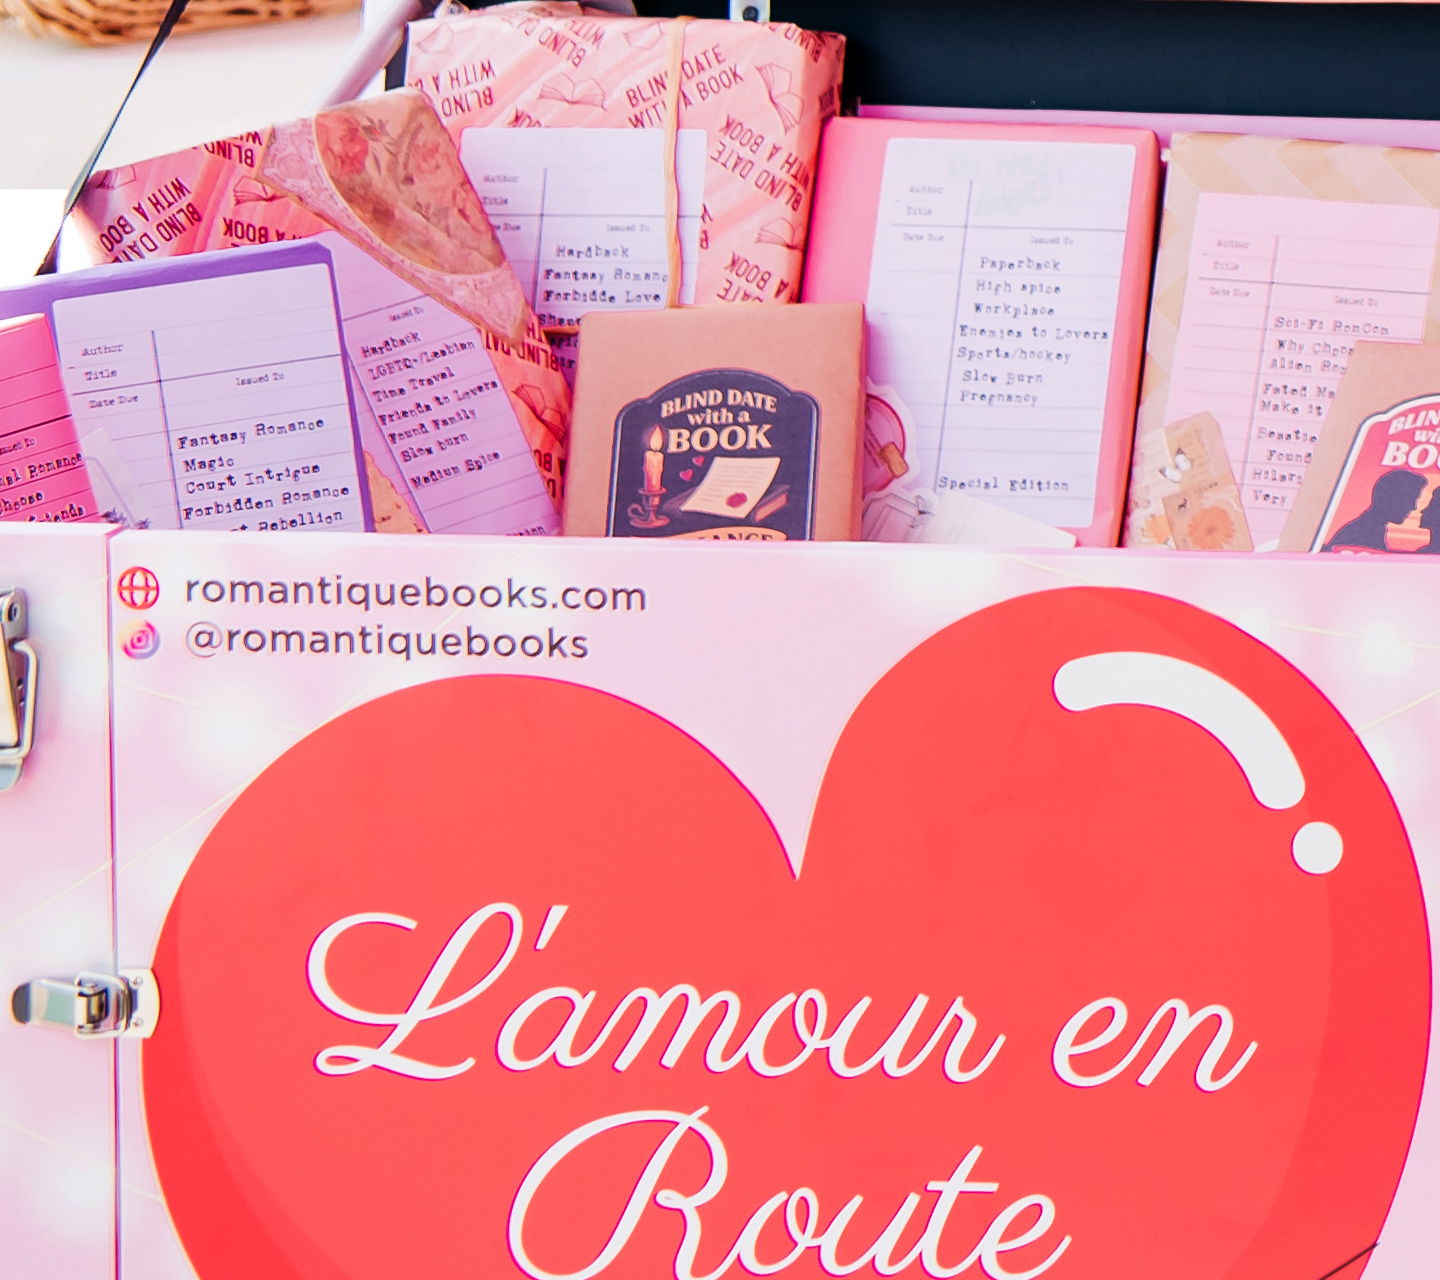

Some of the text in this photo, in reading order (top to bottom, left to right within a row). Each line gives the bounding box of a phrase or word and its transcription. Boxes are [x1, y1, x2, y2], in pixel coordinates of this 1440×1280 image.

[696, 63, 745, 102] BOOK
[441, 86, 494, 118] BLIND
[718, 114, 765, 155] BOOK
[156, 202, 202, 242] BLIND
[543, 268, 606, 286] Fantasy
[979, 256, 1062, 272] Paperback
[974, 302, 1056, 319] Workplace
[1056, 327, 1109, 340] Lovers
[1274, 316, 1390, 336] Sci-Fi RomCom
[956, 346, 1072, 365] Sports/hockey
[408, 366, 455, 391] Travel
[452, 379, 499, 402] Lovers
[660, 388, 778, 419] BLIND DATE
[960, 389, 1039, 407] Pregnancy
[687, 407, 751, 426] with a
[177, 416, 325, 451] Fantasy Romance
[667, 423, 773, 454] BOOK
[183, 455, 235, 474] Magic
[185, 461, 321, 494] Court Intrigue
[937, 476, 999, 490] Special
[183, 484, 350, 521] Forbidden Romance
[258, 508, 343, 532] Rebellion
[185, 573, 648, 612] romantiquebooks.com
[186, 620, 590, 662] @romantiquebooks
[303, 900, 1259, 1097] L'amour en
[502, 1102, 1074, 1280] Route
